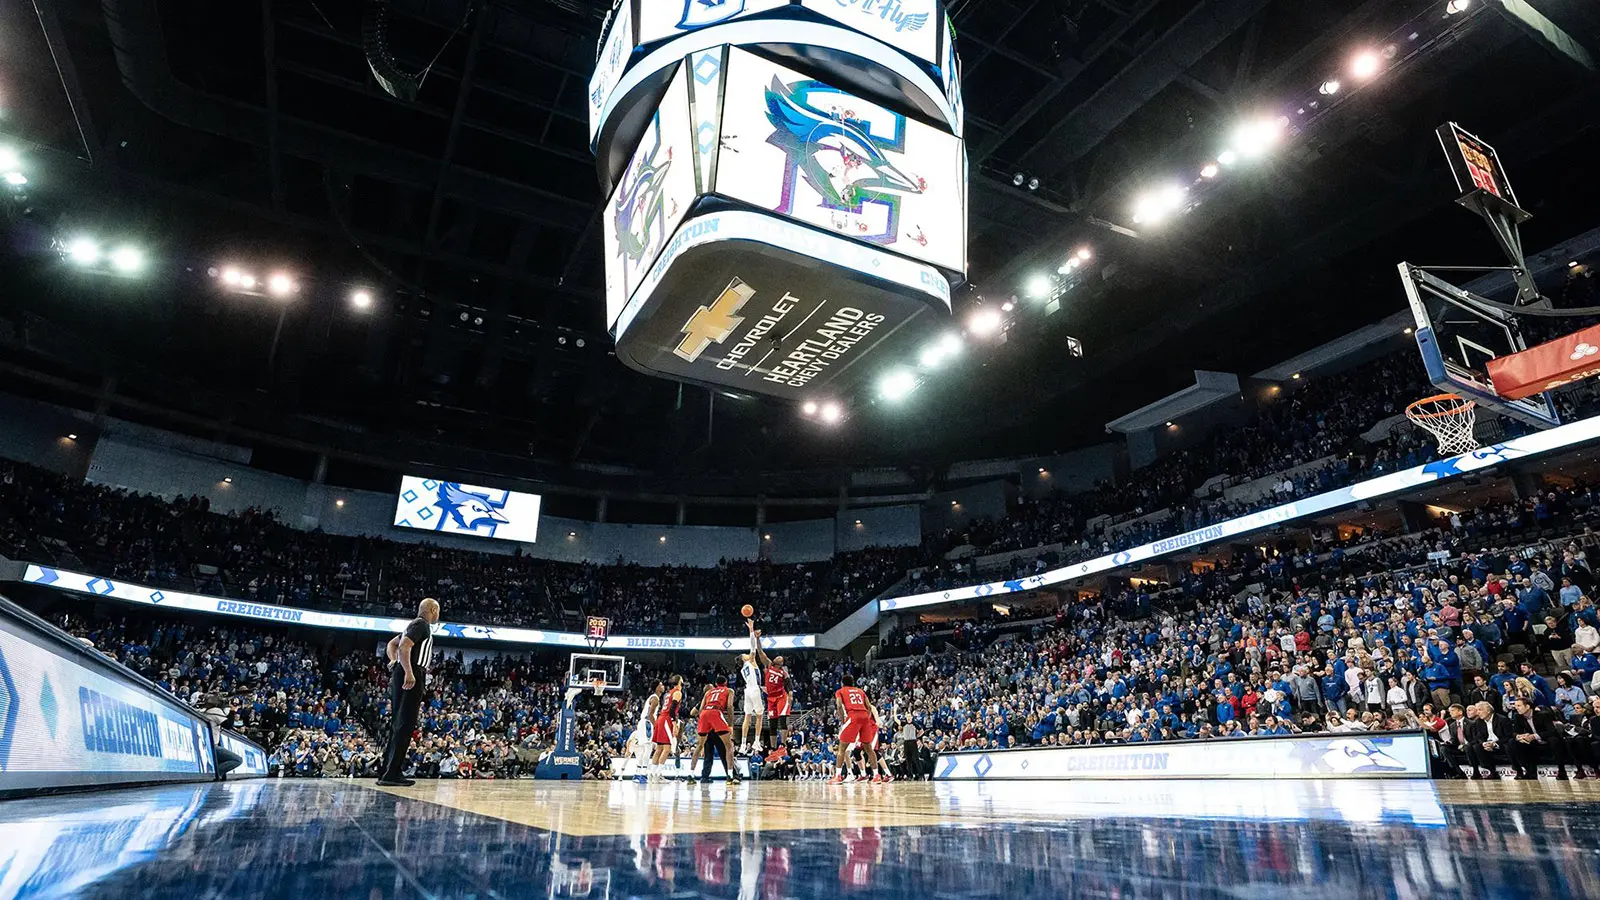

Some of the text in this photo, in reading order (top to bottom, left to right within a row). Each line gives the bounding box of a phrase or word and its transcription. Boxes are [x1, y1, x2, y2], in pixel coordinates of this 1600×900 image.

[652, 218, 720, 282] CREIGHTON
[716, 291, 800, 370] CHEVROLET
[763, 306, 864, 384] HEARTLAND
[787, 313, 885, 387] CHEVY DEALERS
[1152, 525, 1223, 554] CREIGHTON
[216, 600, 303, 622] CREIGHTON
[626, 638, 685, 648] BLUEJAYS
[769, 674, 779, 684] 24
[710, 692, 720, 701] 11
[849, 693, 863, 704] 23
[79, 686, 162, 758] CREIGHTON
[1067, 753, 1170, 772] CREIGHTON
